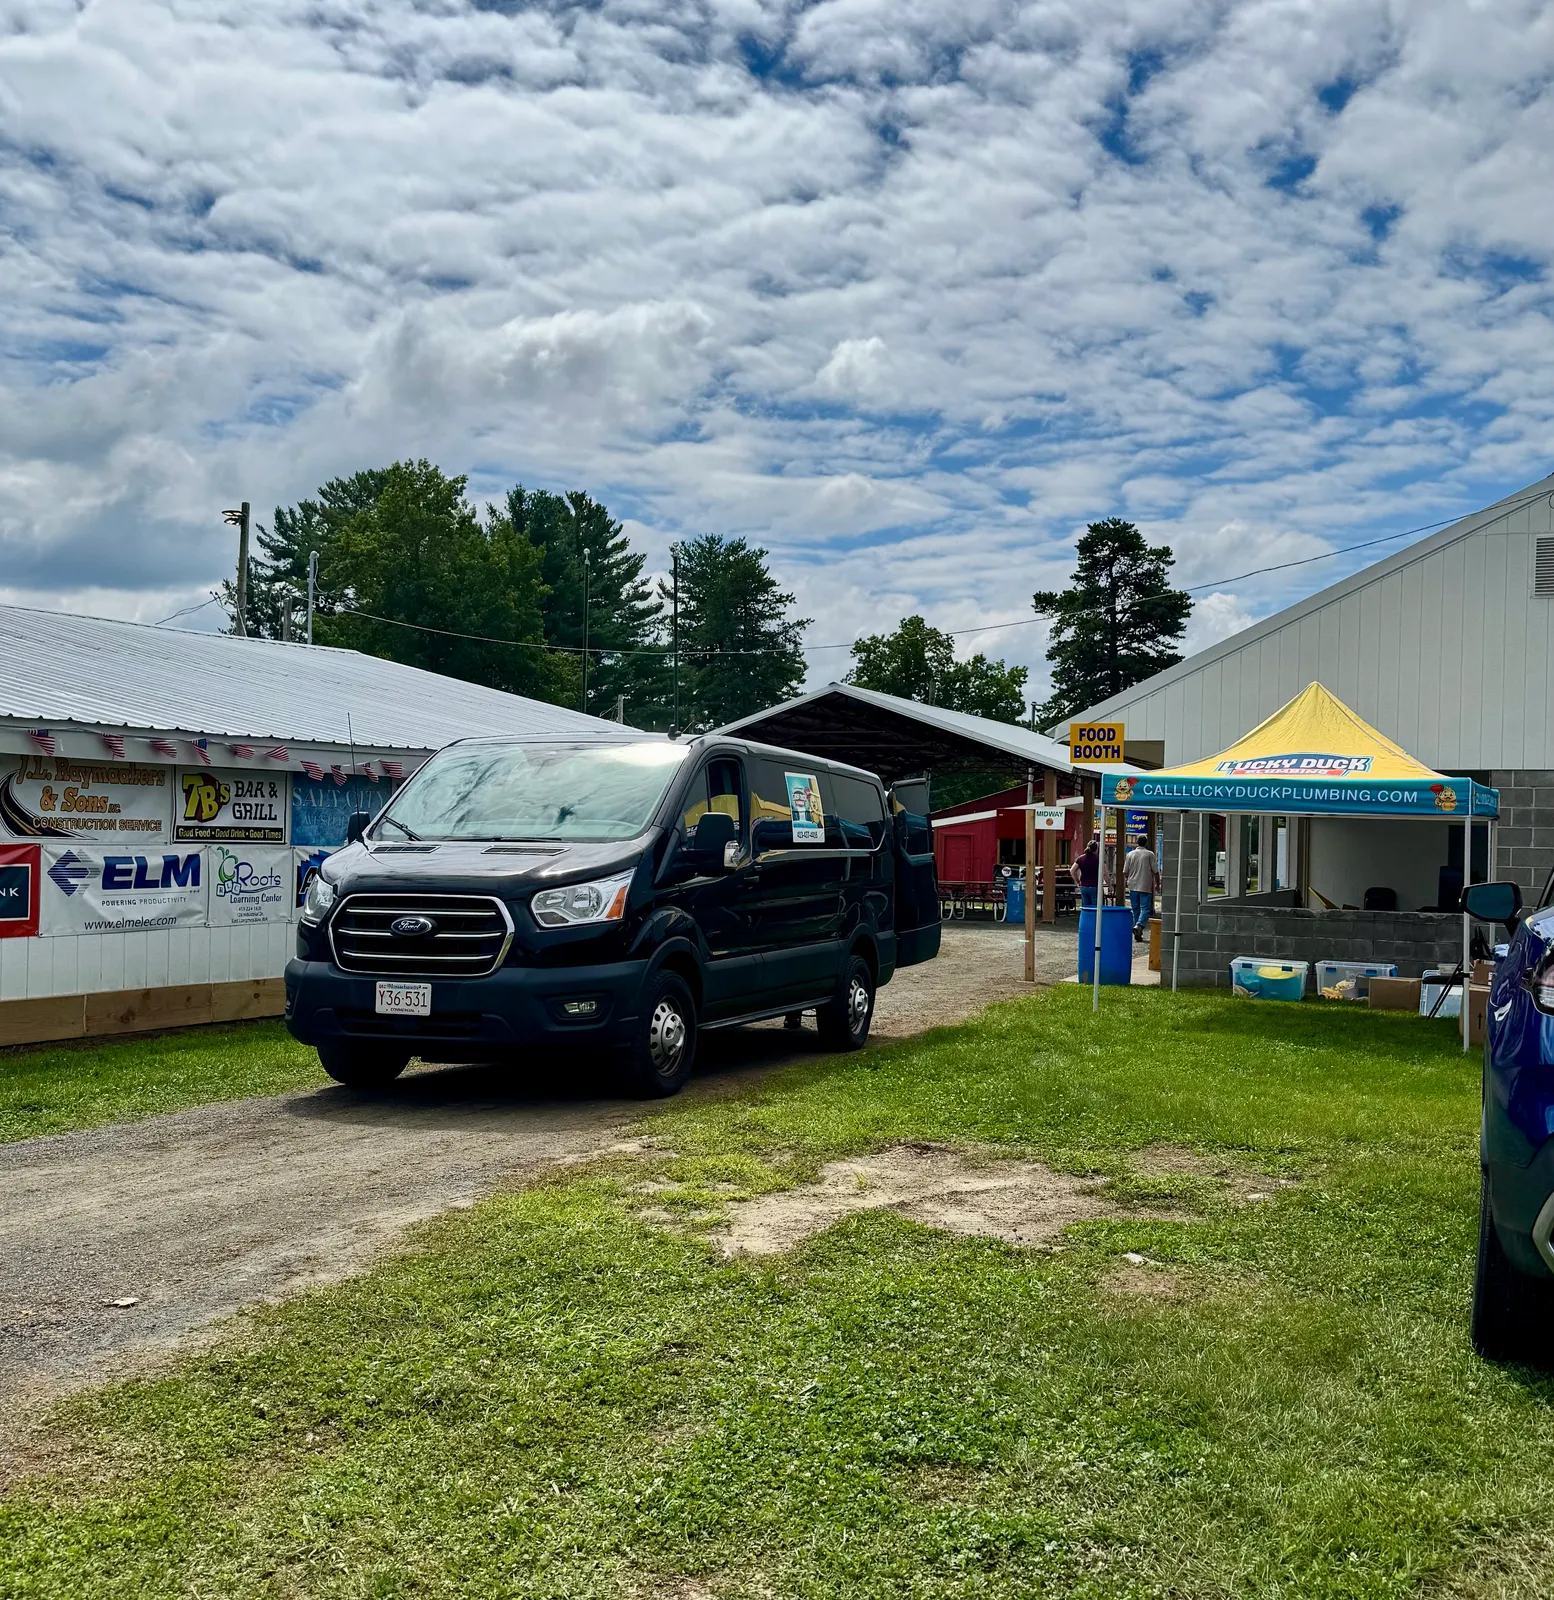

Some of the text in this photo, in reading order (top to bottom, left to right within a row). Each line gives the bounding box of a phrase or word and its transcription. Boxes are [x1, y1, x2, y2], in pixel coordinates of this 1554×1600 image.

[1079, 727, 1116, 742] FOOD
[1073, 745, 1121, 759] BOOTH
[1222, 757, 1368, 771] LUCKY DUCK
[16, 756, 165, 788] J.L. Raymaakers
[234, 780, 278, 799] BAR &
[1143, 783, 1418, 803] CALLLUCKYDUCKPLUMBING.COM
[40, 786, 57, 812] &
[61, 786, 109, 813] Sons
[292, 786, 386, 809] SALT CITY
[232, 803, 278, 821] GRILL
[1036, 810, 1063, 818] MIDWAY
[1131, 814, 1149, 822] Gyros
[32, 817, 162, 832] CONSTRUCTION SERVICE
[178, 828, 282, 839] Good Food Good Drink Good Times
[102, 854, 200, 890] ELM
[234, 861, 281, 887] Roots
[101, 896, 187, 907] POWERING PRODUCTIVITY
[230, 893, 282, 905] Learning Center
[84, 915, 177, 931] www.elmelec.com
[398, 920, 421, 931] Ford
